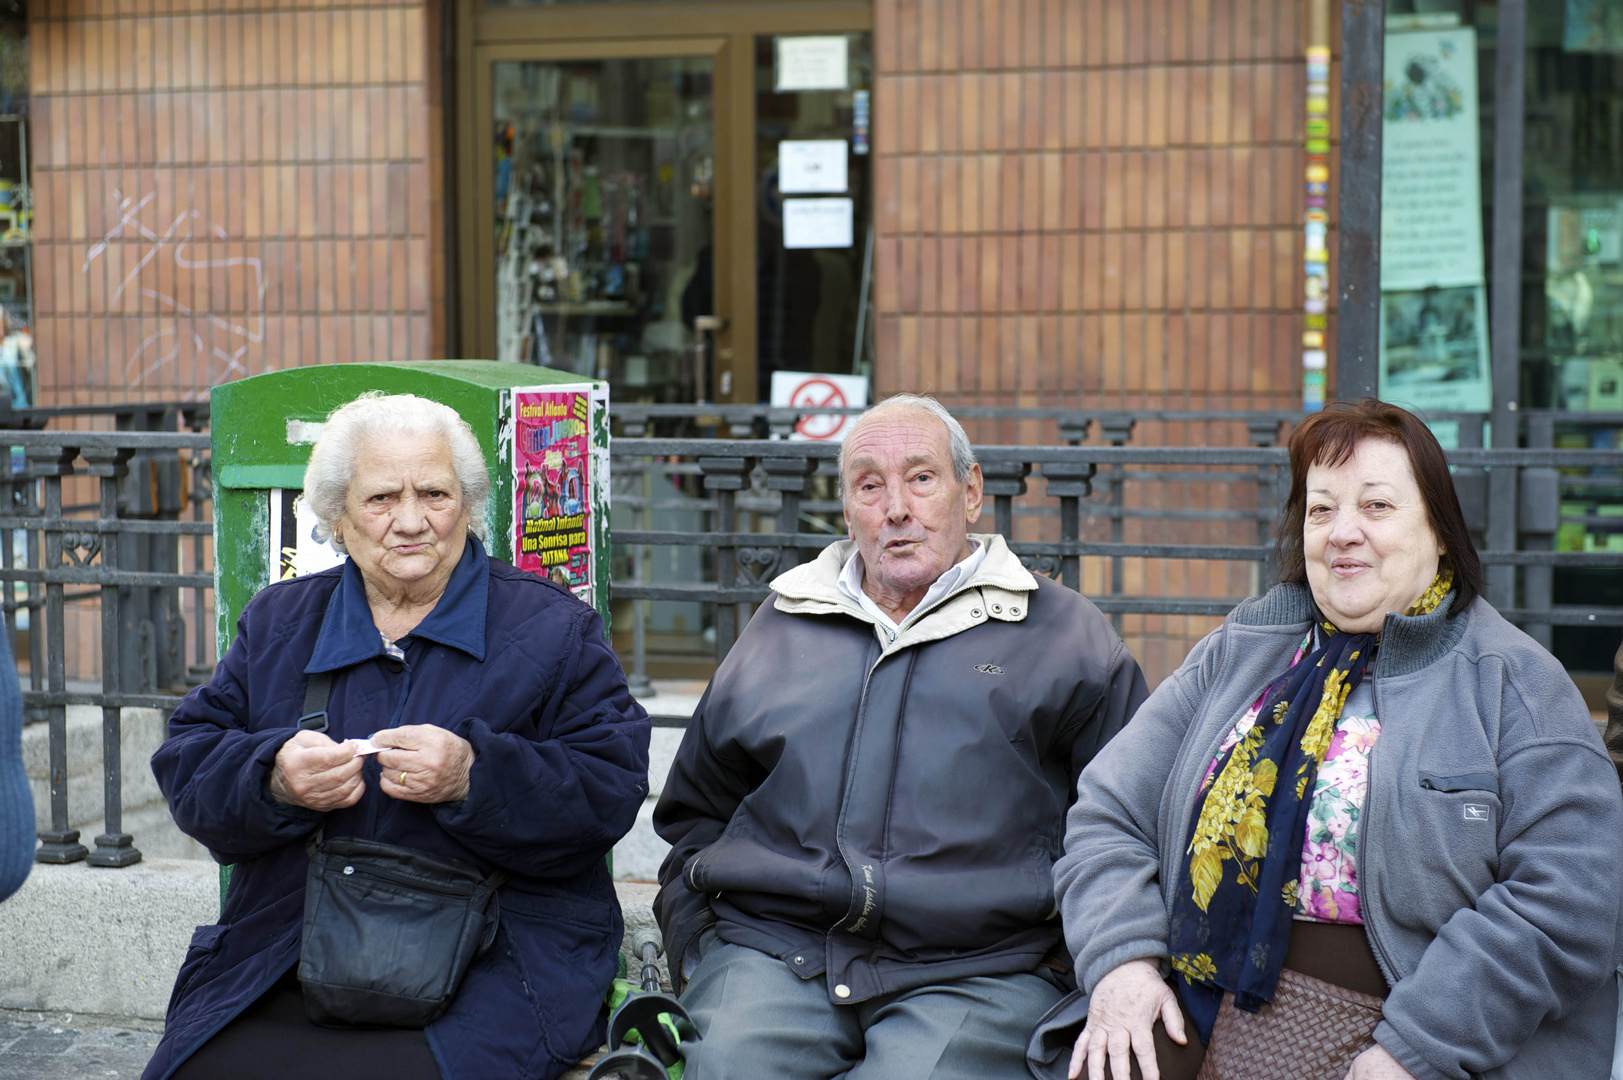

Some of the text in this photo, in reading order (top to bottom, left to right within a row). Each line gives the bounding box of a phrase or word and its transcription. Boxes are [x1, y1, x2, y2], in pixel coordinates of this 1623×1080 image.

[520, 401, 543, 417] Festival
[545, 401, 568, 416] Atlanta
[525, 516, 556, 533] Matinal
[522, 531, 586, 552] Una Sonrisa para
[541, 549, 569, 566] AITANA
